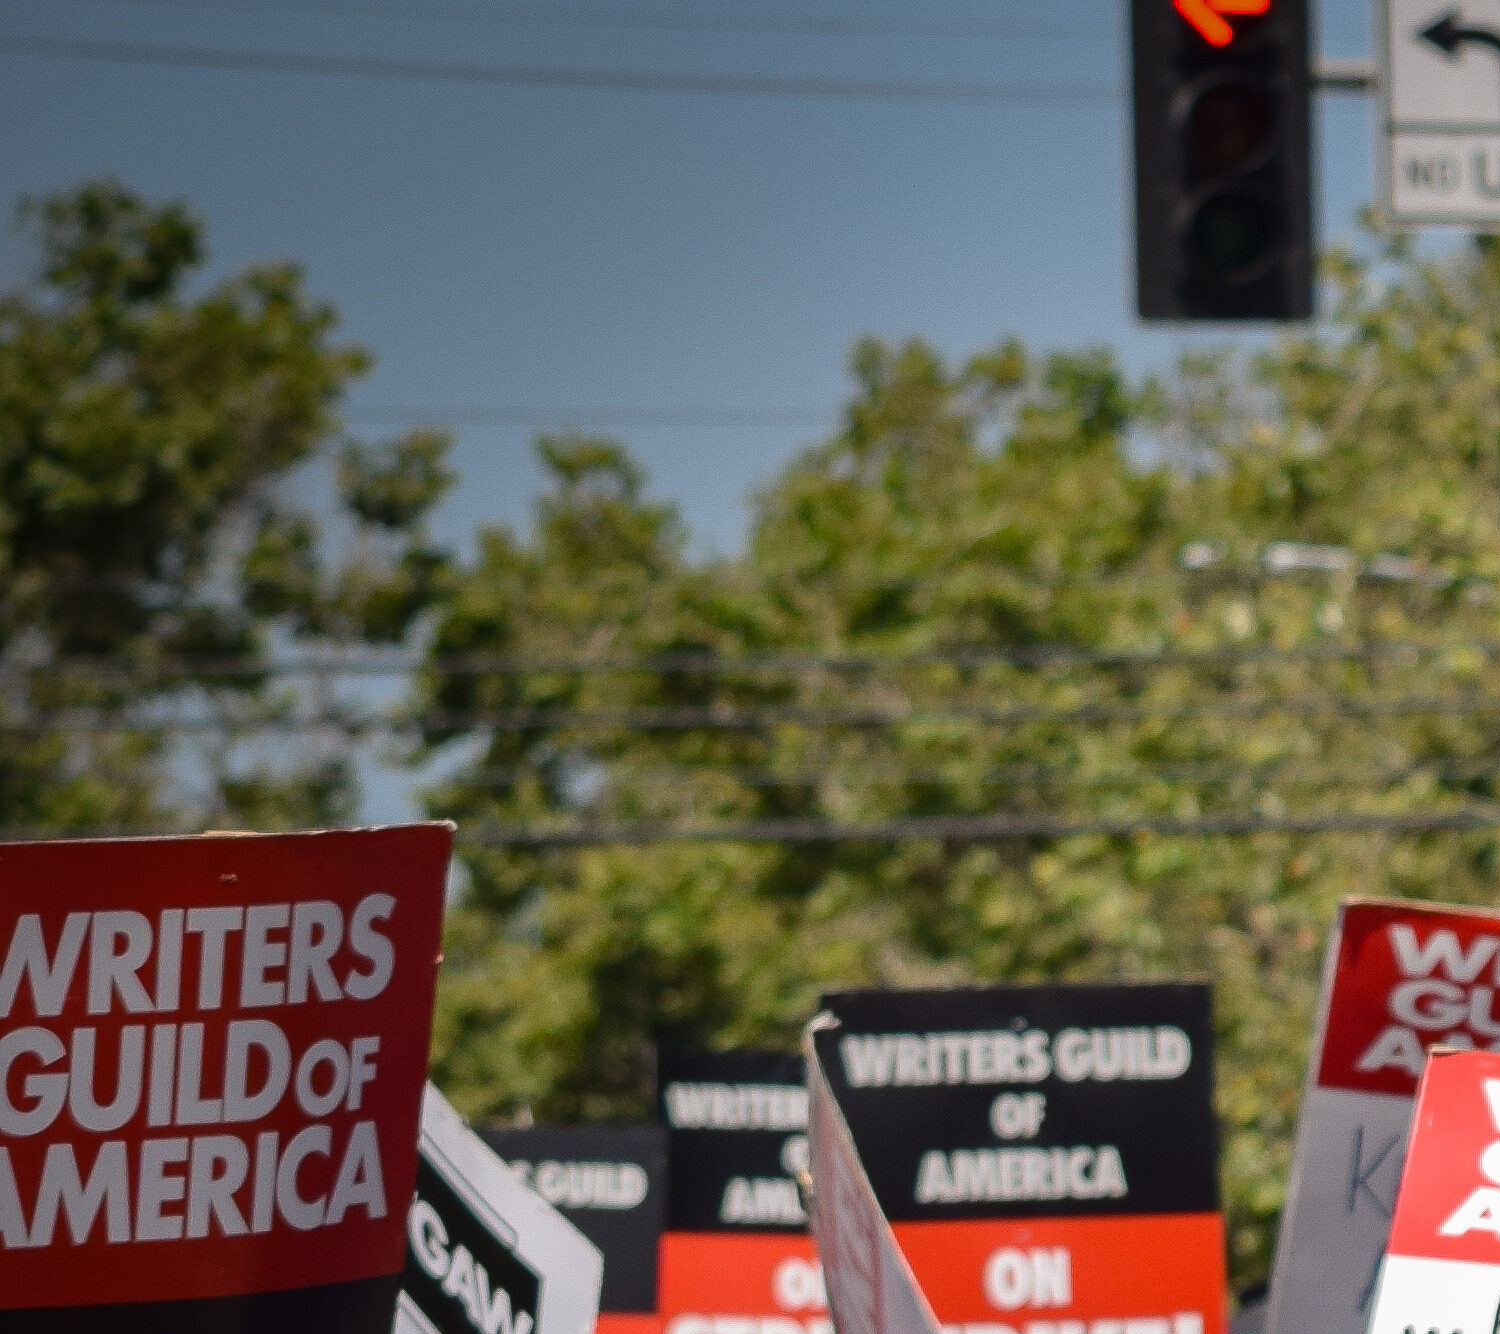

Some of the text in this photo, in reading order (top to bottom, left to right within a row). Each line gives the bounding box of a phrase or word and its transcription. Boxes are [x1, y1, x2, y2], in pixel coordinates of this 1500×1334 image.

[0, 893, 397, 1018] WRITERS
[0, 1019, 381, 1136] GUILD OF
[841, 1027, 1193, 1086] WRITERS GUILD
[989, 1093, 1046, 1139] OF
[0, 1120, 387, 1250] AMERICA
[916, 1145, 1128, 1201] AMERICA
[984, 1247, 1072, 1308] ON
